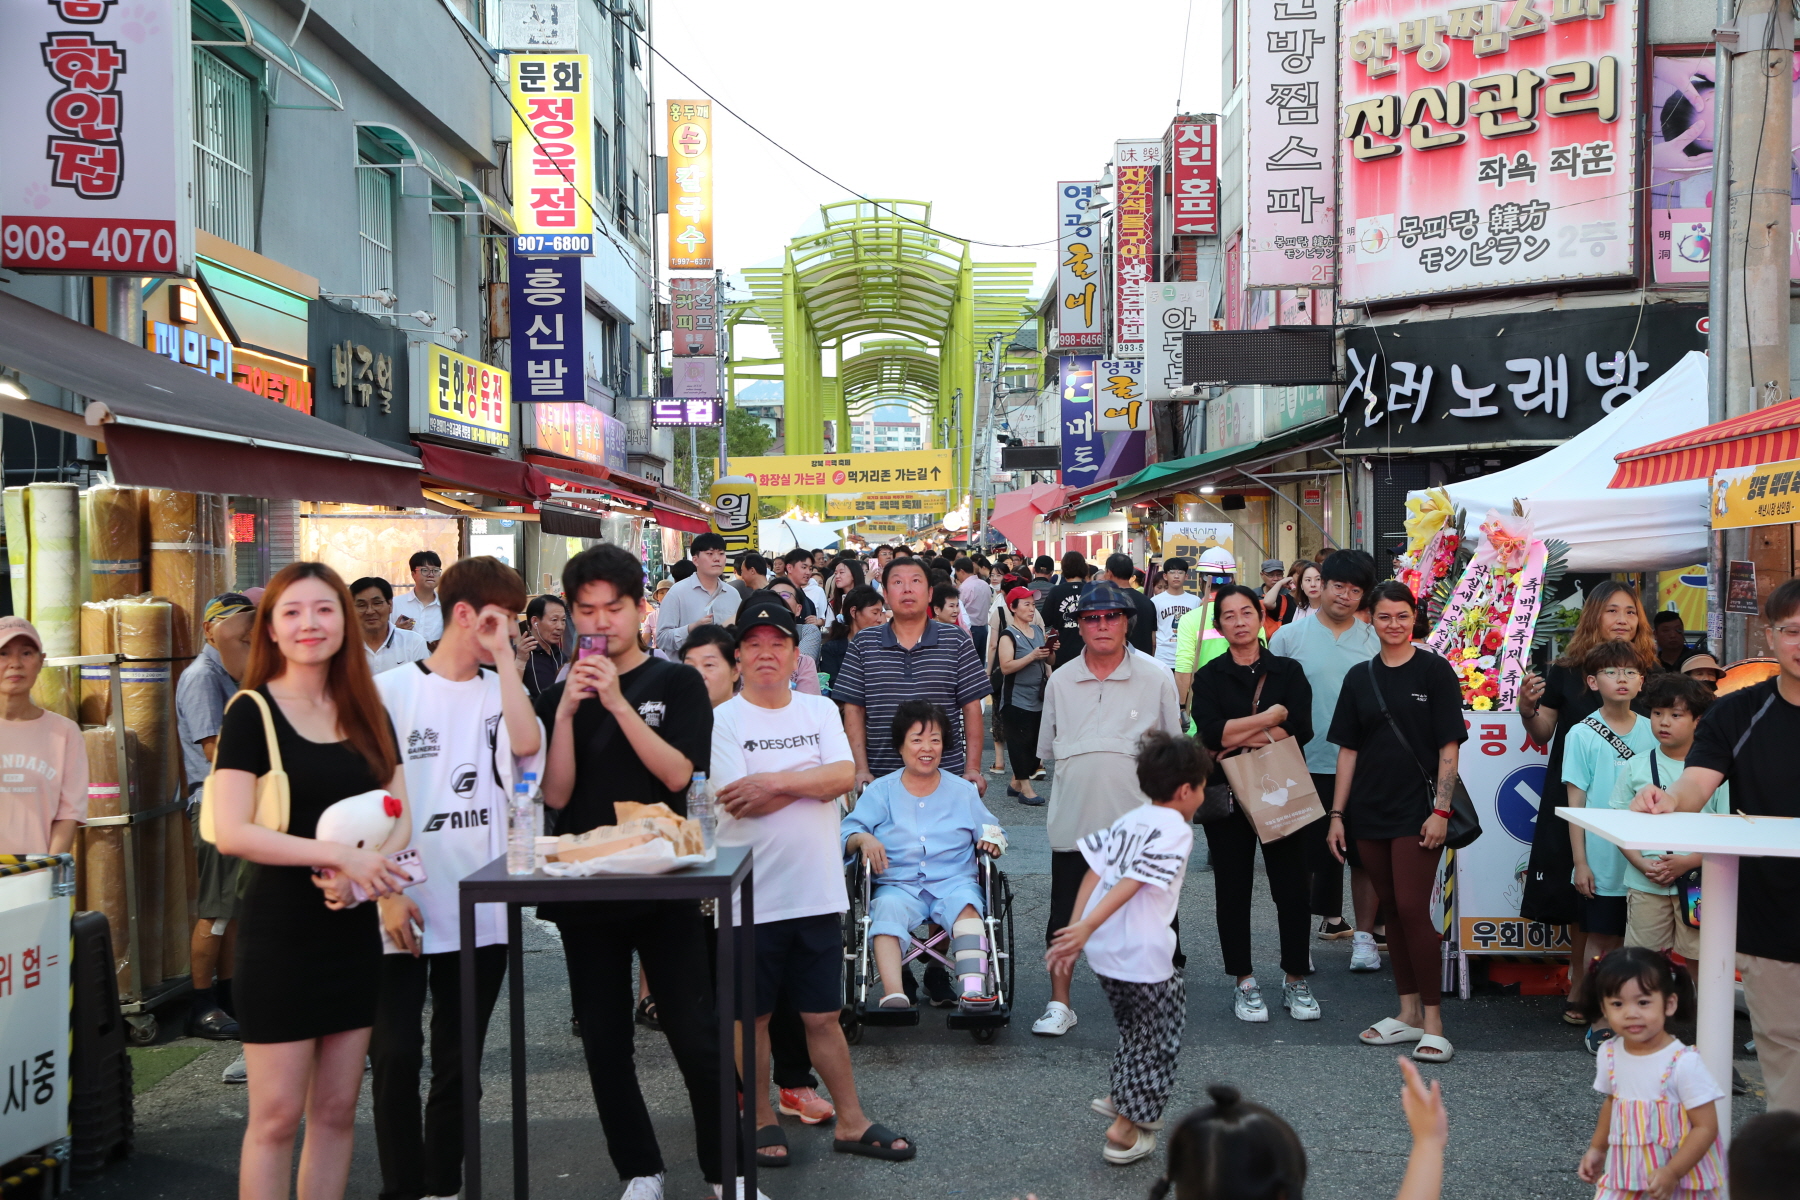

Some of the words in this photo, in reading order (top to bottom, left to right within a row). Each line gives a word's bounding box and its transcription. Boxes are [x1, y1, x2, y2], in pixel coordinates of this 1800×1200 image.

[519, 62, 582, 93] 문화
[1345, 57, 1620, 160] 전신관리
[527, 98, 576, 228] 정육점
[1478, 155, 1537, 187] 좌욕
[1551, 144, 1614, 178] 좌훈
[1399, 210, 1479, 247] 몽피랑
[1489, 201, 1550, 235] 韓方
[1559, 222, 1618, 257] 2층
[3, 225, 173, 263] 908-4070
[517, 235, 590, 251] 907-6800
[1420, 234, 1549, 272] モンピラン
[1658, 230, 1671, 260] 明洞
[1311, 264, 1333, 281] 2F
[523, 257, 568, 396] 흥신발
[1060, 334, 1102, 346] 998-6456
[1101, 361, 1143, 375] 영광
[438, 353, 464, 414] 문화
[467, 365, 502, 424] 정육점
[760, 473, 791, 486] 화장실
[794, 472, 825, 486] 가는길
[848, 469, 891, 483] 먹거리존
[895, 467, 927, 481] 가는길
[855, 501, 875, 510] 강북
[902, 499, 921, 509] 축제
[1610, 735, 1632, 758] 1980
[0, 754, 57, 780] NDARD
[3, 1050, 55, 1115] 사중
